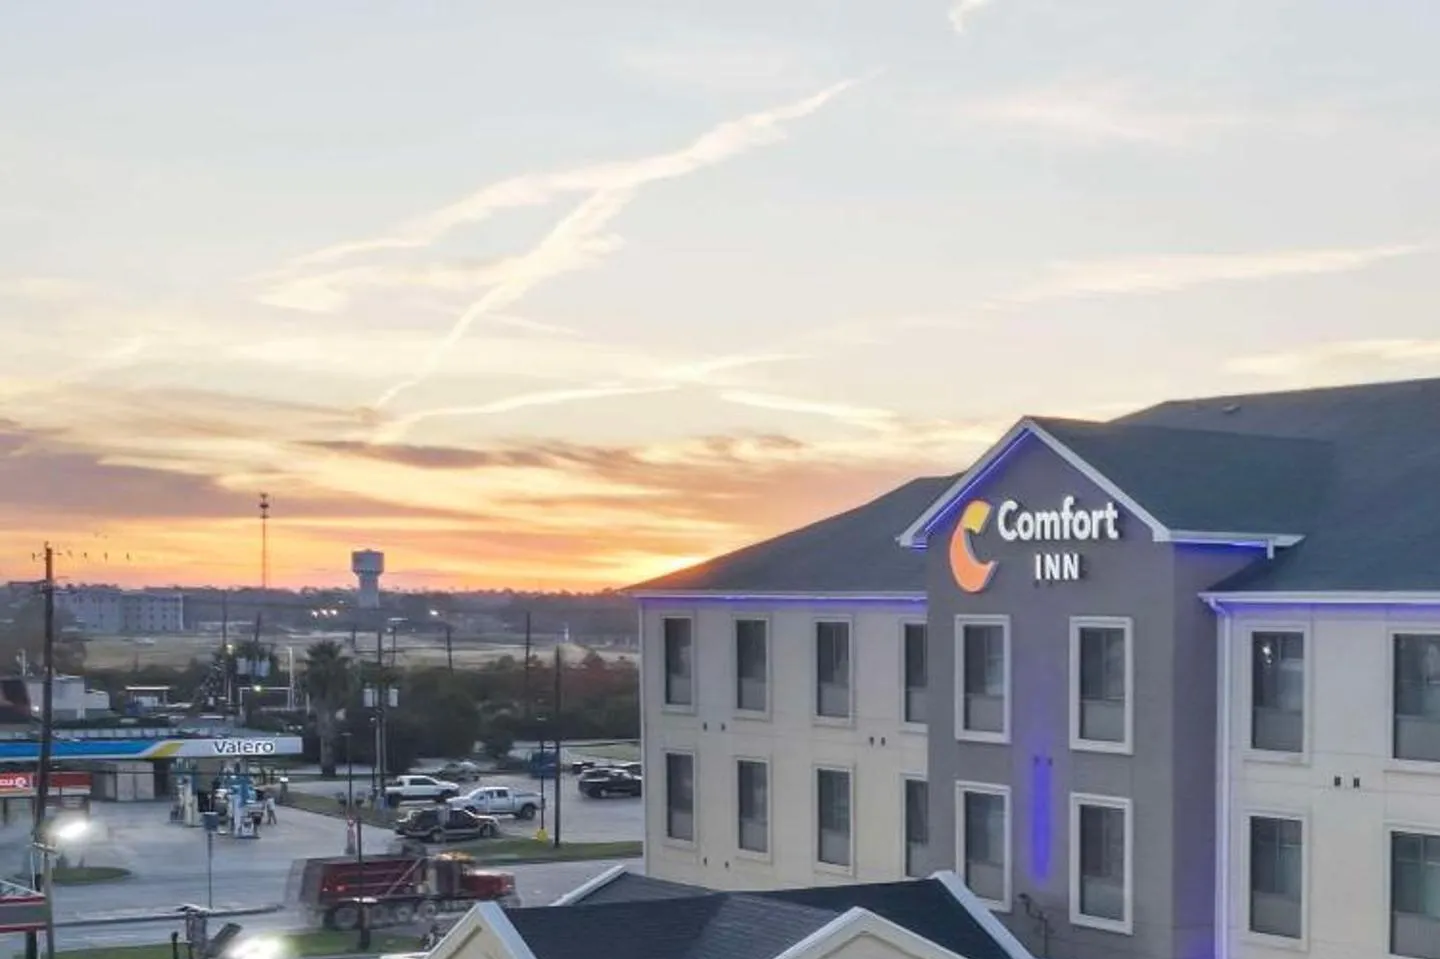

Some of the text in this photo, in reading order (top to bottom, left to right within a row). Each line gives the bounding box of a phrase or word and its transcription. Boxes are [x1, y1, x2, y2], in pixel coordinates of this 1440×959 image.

[998, 496, 1119, 541] Comfort
[1034, 553, 1080, 580] INN
[213, 740, 274, 754] Valero
